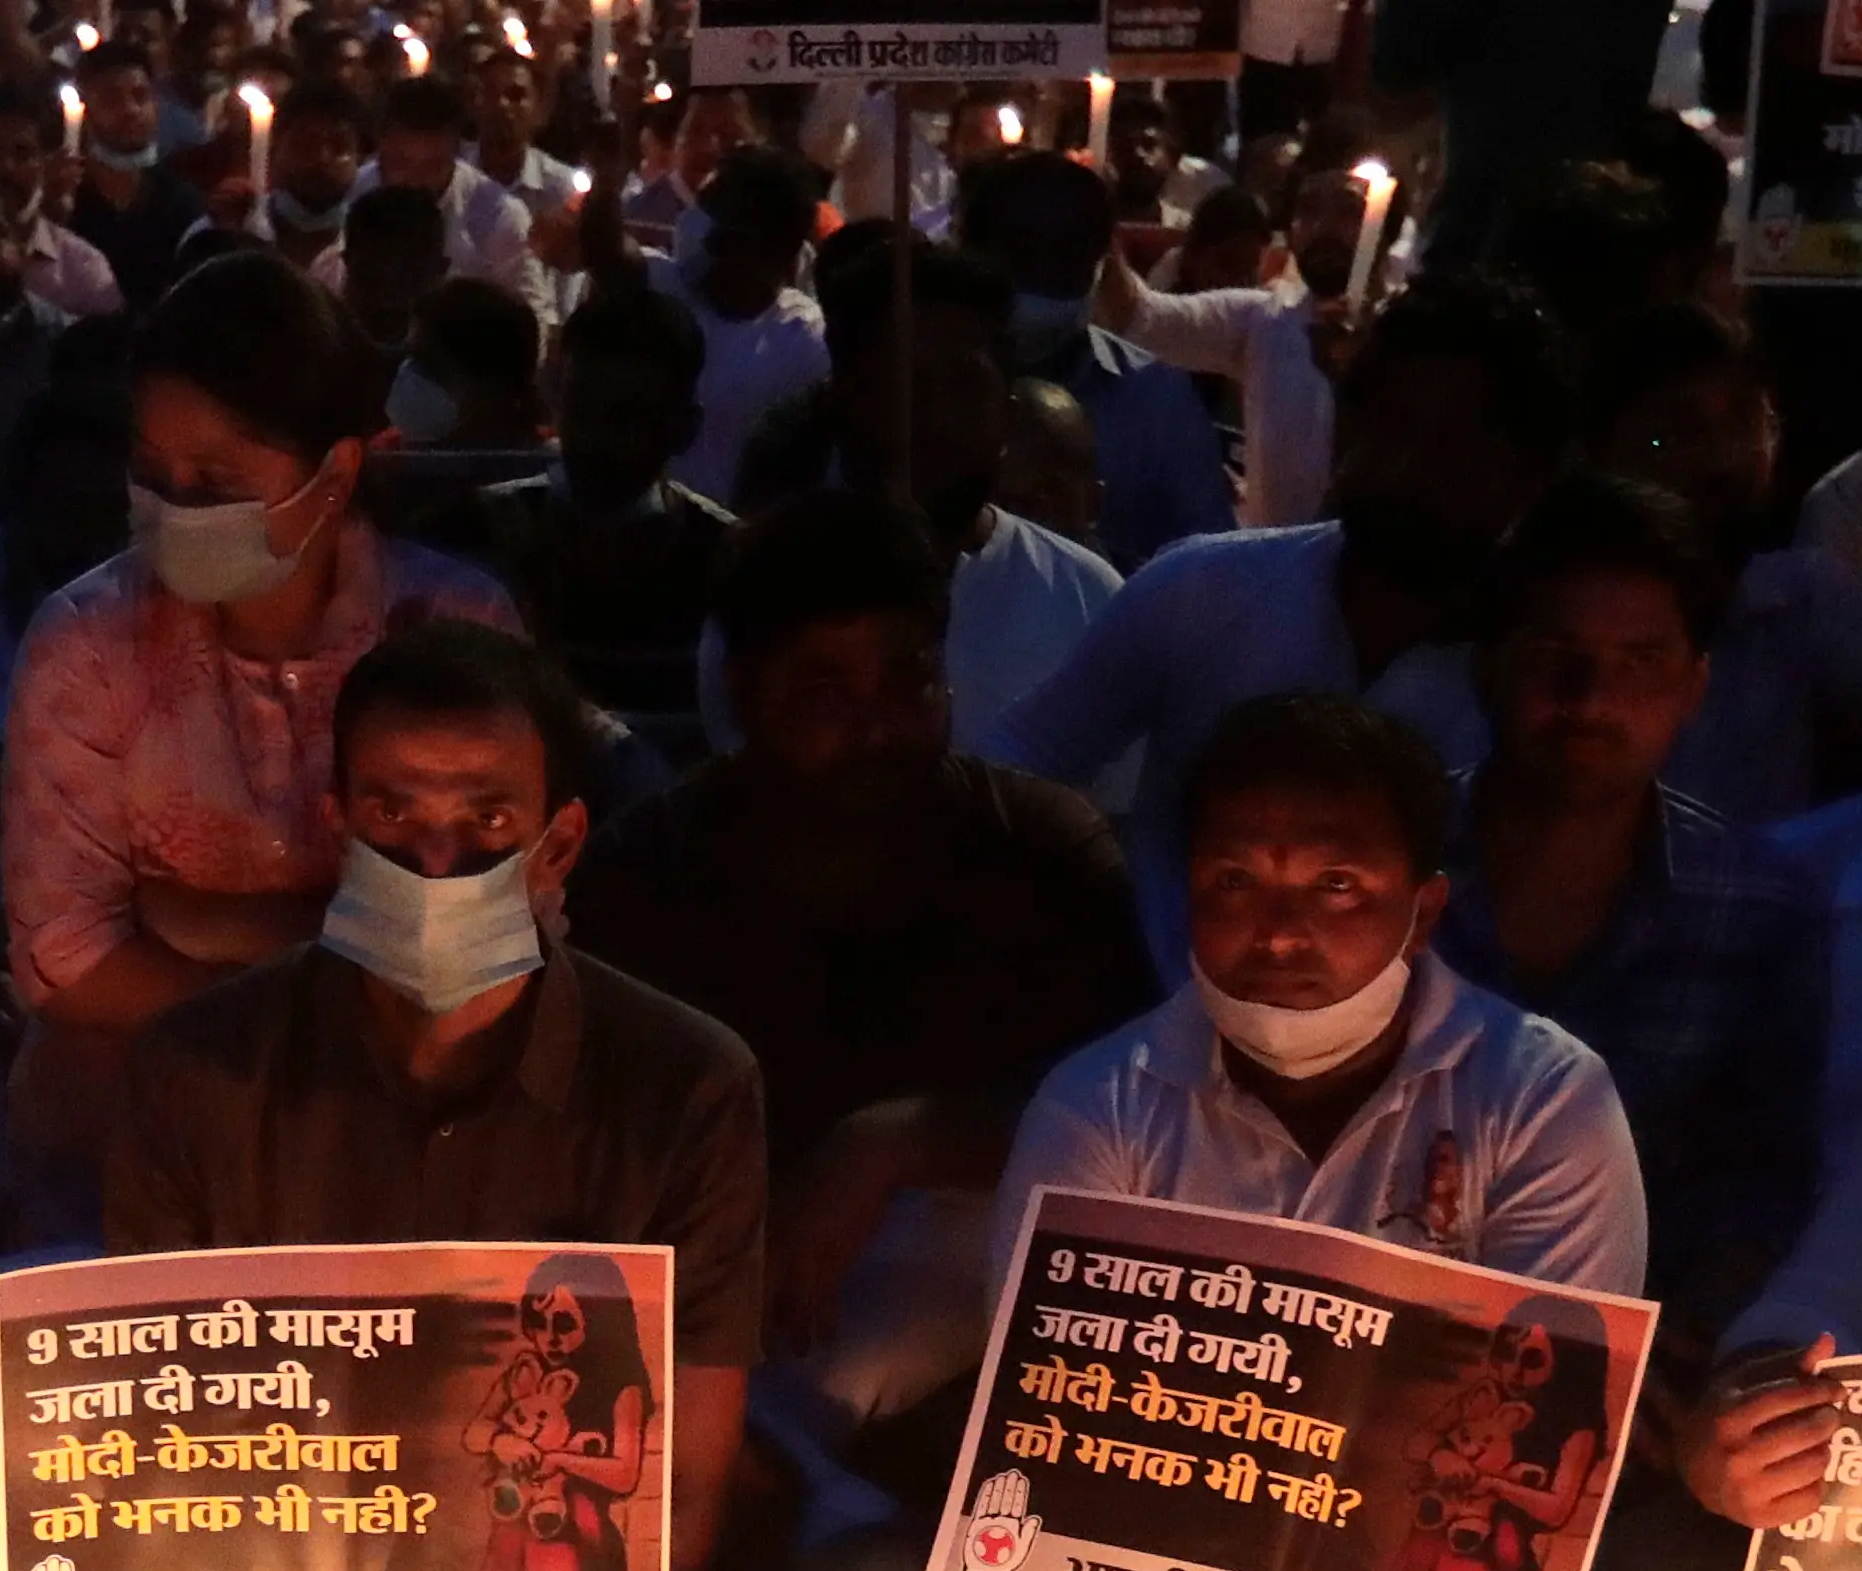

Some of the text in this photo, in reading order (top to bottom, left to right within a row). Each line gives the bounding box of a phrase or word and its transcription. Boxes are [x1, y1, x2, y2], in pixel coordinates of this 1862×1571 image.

[788, 30, 862, 69] दिल्ली
[27, 1299, 417, 1365] 9 साल की मासूम
[1047, 1249, 1393, 1351] 9 साल की मासूम
[1031, 1303, 1304, 1395] जला दी गयी,
[27, 1358, 331, 1424] जला दी गयी,
[1018, 1355, 1346, 1464] मोदी-केजरीवाल
[28, 1422, 402, 1483] मोदी-केजरीवाल
[1002, 1414, 1365, 1530] को भनक भी नही?
[30, 1483, 438, 1544] को भनक भी नही?
